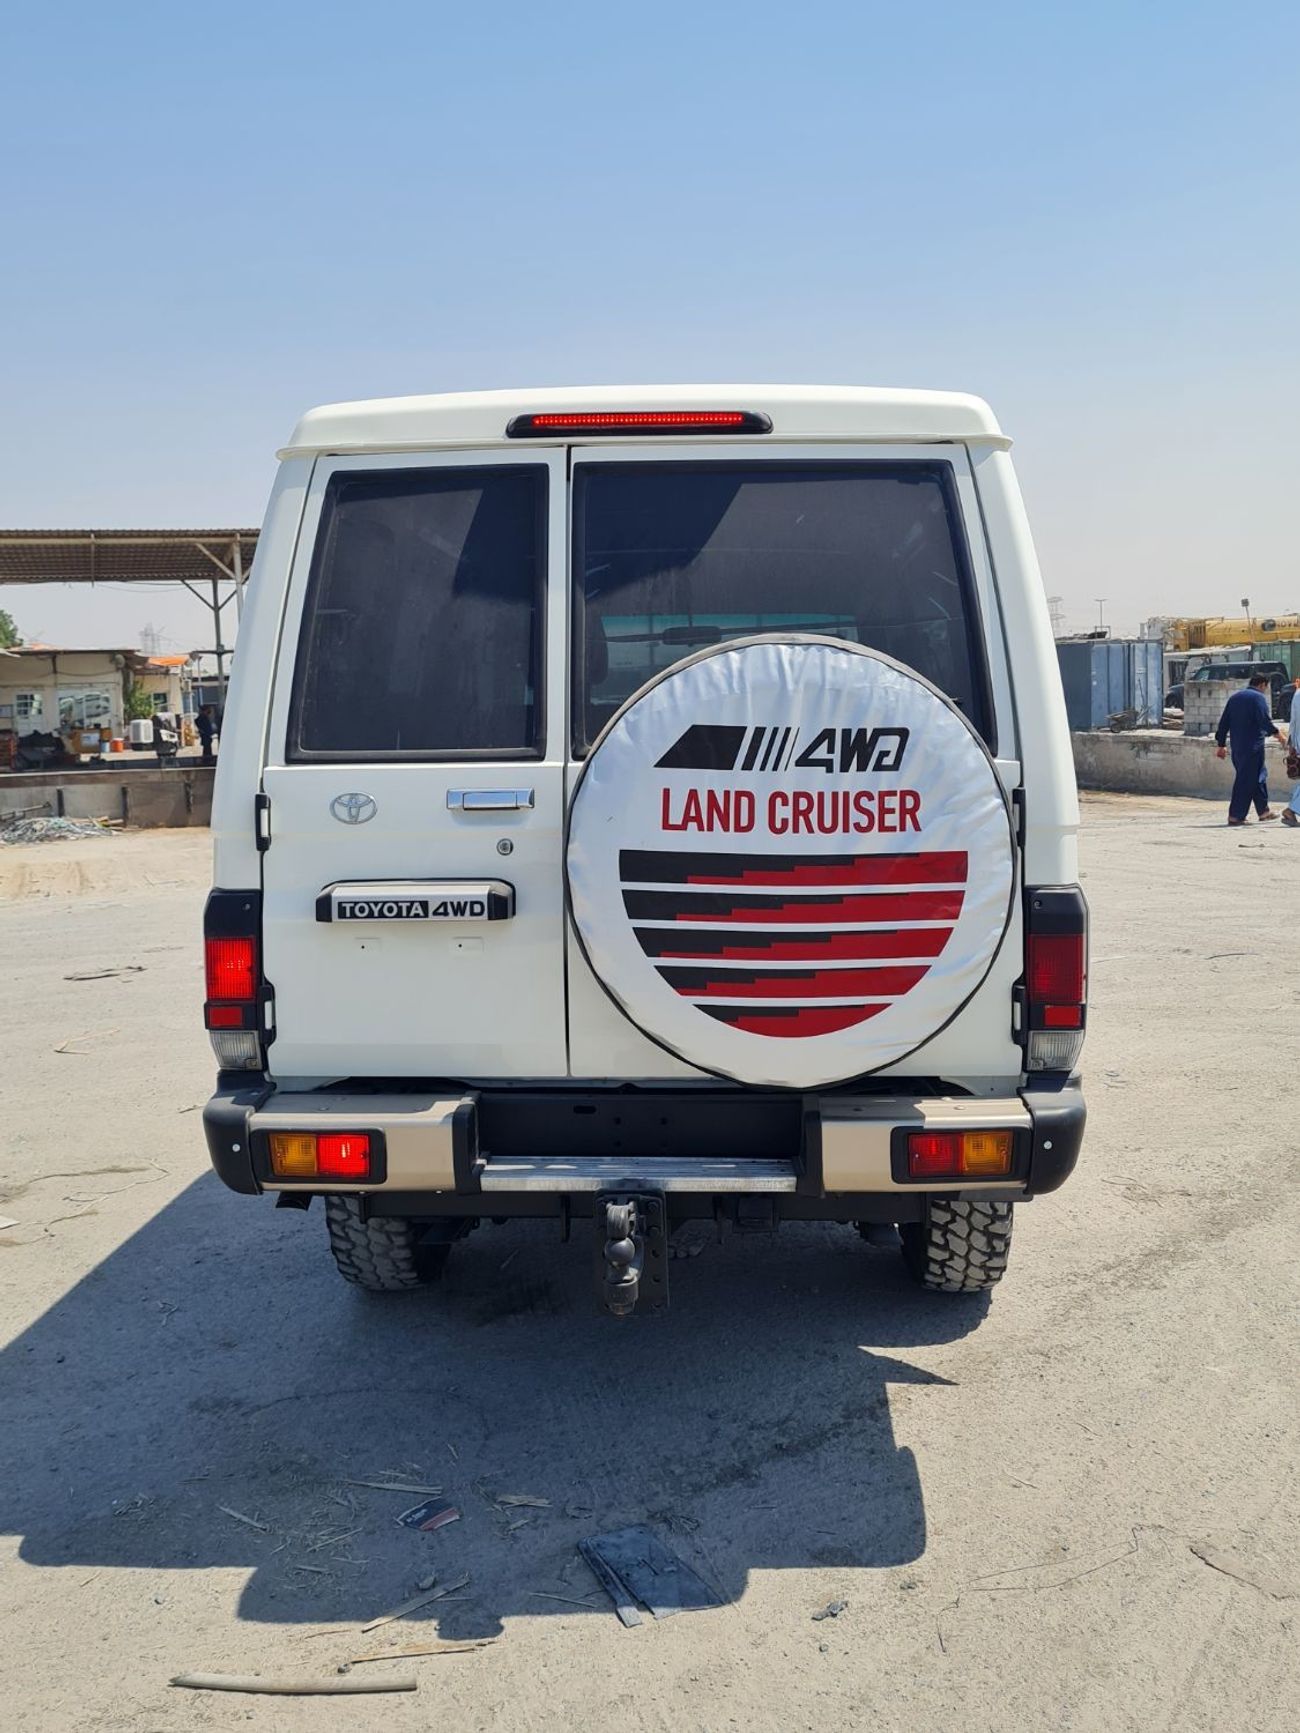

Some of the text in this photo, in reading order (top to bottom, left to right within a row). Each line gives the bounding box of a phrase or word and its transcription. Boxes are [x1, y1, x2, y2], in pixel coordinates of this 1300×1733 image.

[794, 727, 910, 774] 4WD
[661, 787, 922, 835] LAND CRUISER
[341, 900, 486, 918] TOYOTA 4WD
